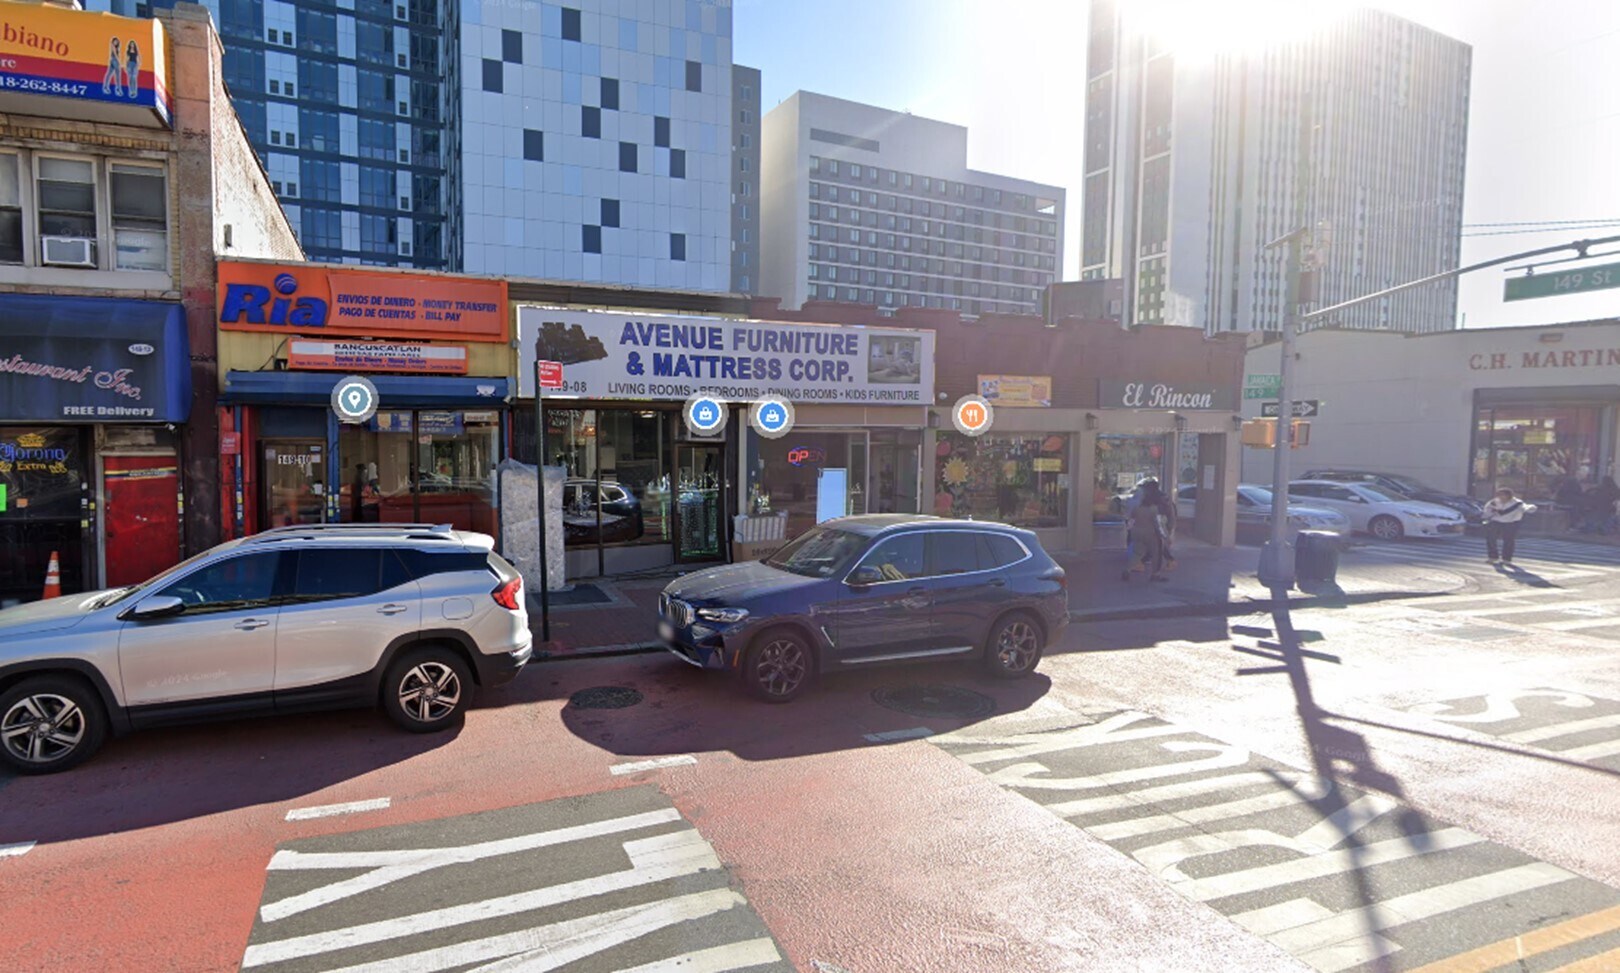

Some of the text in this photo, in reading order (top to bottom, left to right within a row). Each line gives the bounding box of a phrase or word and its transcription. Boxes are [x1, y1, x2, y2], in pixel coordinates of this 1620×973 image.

[4, 22, 69, 57] biano
[1554, 270, 1612, 290] 149 St
[220, 273, 328, 328] Ria
[337, 294, 497, 313] ENVIOS DE DINERO MONEY TRANSFER
[339, 307, 461, 321] PAGO DE CUENTAS BILL PAY
[619, 322, 858, 355] AVENUE FURNITURE
[626, 351, 854, 383] & MATTRESS CORP.
[1469, 349, 1620, 370] C.H. MARTIN
[608, 382, 919, 401] LIVING ROOMS BEDROOMS DINING ROOMS KIDS FURNITURE
[1122, 383, 1212, 408] El Rincon
[63, 406, 154, 416] FREE Delivery
[0, 443, 65, 463] Corona
[278, 455, 311, 464] 149-10
[788, 450, 828, 464] OPEN
[17, 461, 47, 470] Extra
